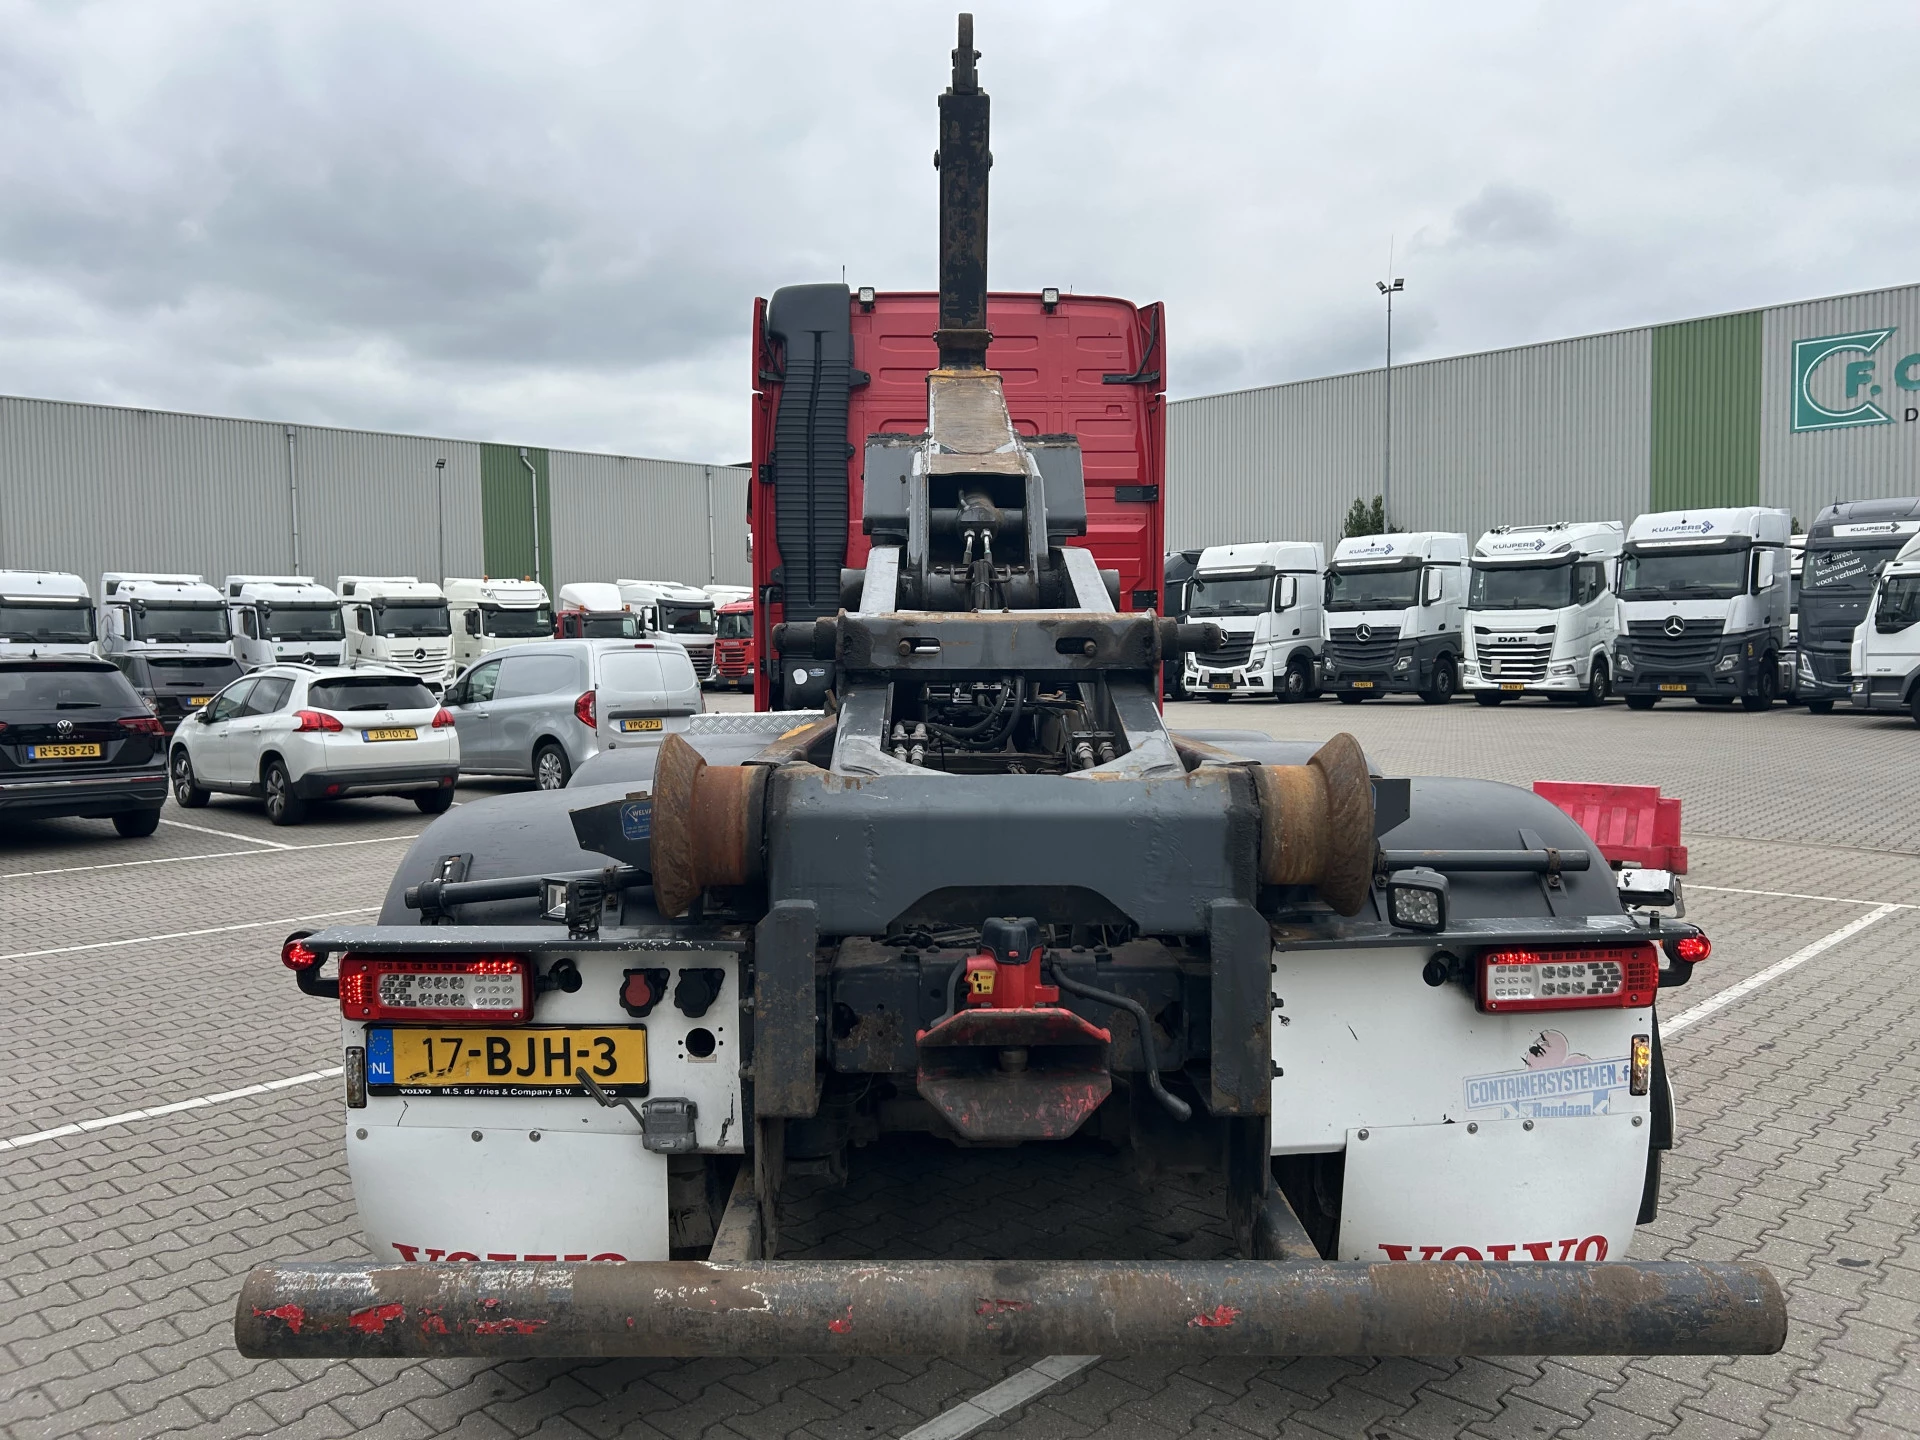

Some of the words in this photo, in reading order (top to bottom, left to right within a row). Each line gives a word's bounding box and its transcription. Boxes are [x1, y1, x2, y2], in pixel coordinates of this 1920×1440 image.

[1651, 525, 1702, 533] KUIJPERS
[1850, 524, 1892, 532] KUIJPERS
[1348, 546, 1386, 554] KUIJPERS
[1816, 557, 1831, 567] Per
[1831, 549, 1854, 562] direct
[1815, 556, 1861, 577] beschikbaar
[1815, 577, 1834, 587] voor
[1834, 564, 1868, 581] verhuur!
[628, 720, 659, 729] VPG-27-J
[374, 729, 412, 739] JB-101-Z
[40, 745, 96, 757] R-538-ZB
[422, 1036, 618, 1077] 17-BJH-3
[372, 1063, 391, 1075] NL
[510, 1088, 553, 1097] Company
